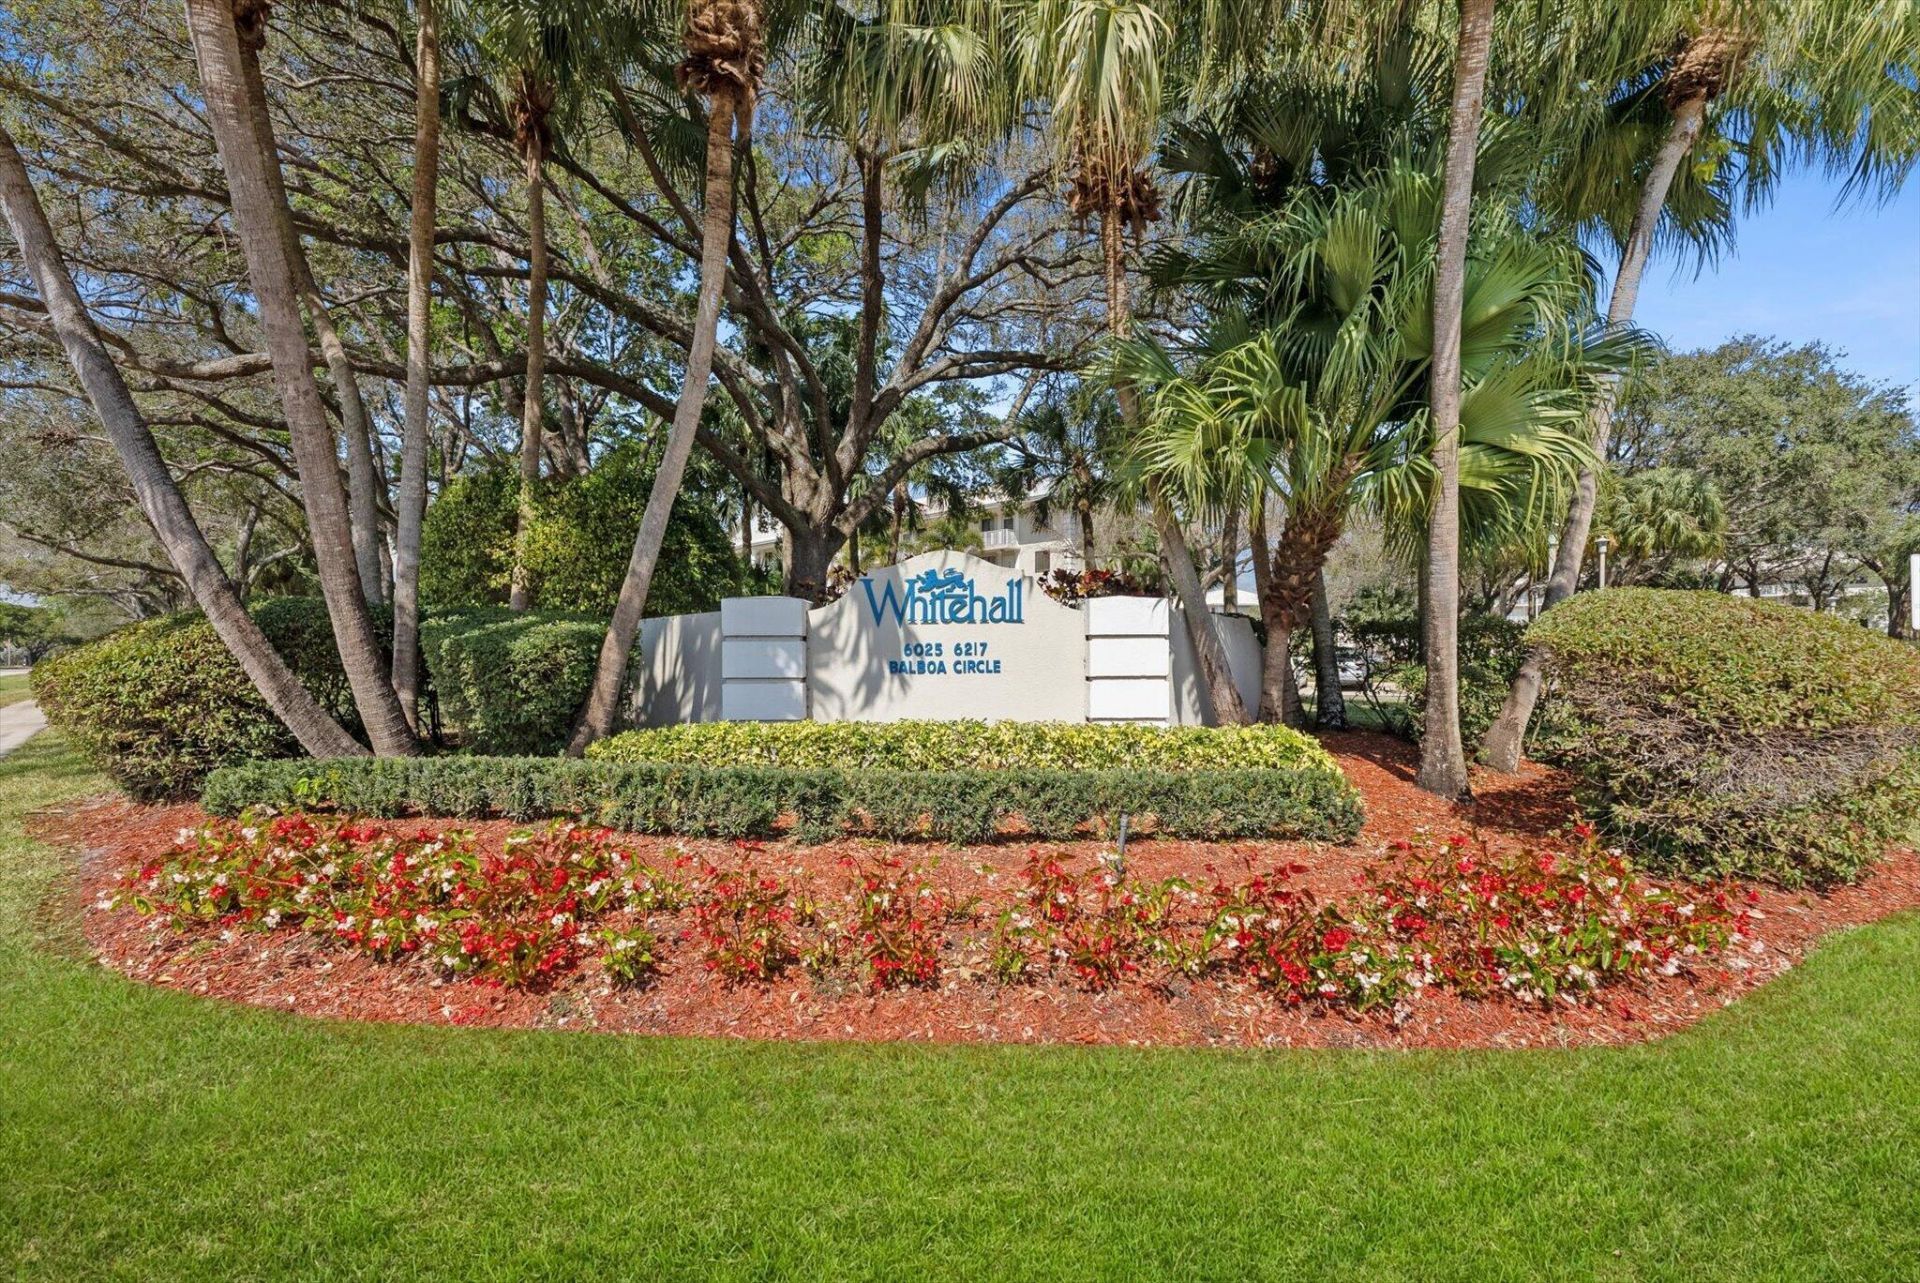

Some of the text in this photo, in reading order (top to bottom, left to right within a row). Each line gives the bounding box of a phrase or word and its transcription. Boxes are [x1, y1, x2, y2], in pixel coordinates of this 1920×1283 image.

[860, 577, 1025, 628] Whitehall
[904, 642, 988, 656] 6025 6217
[889, 660, 1001, 674] BALBOA CIRCLE
